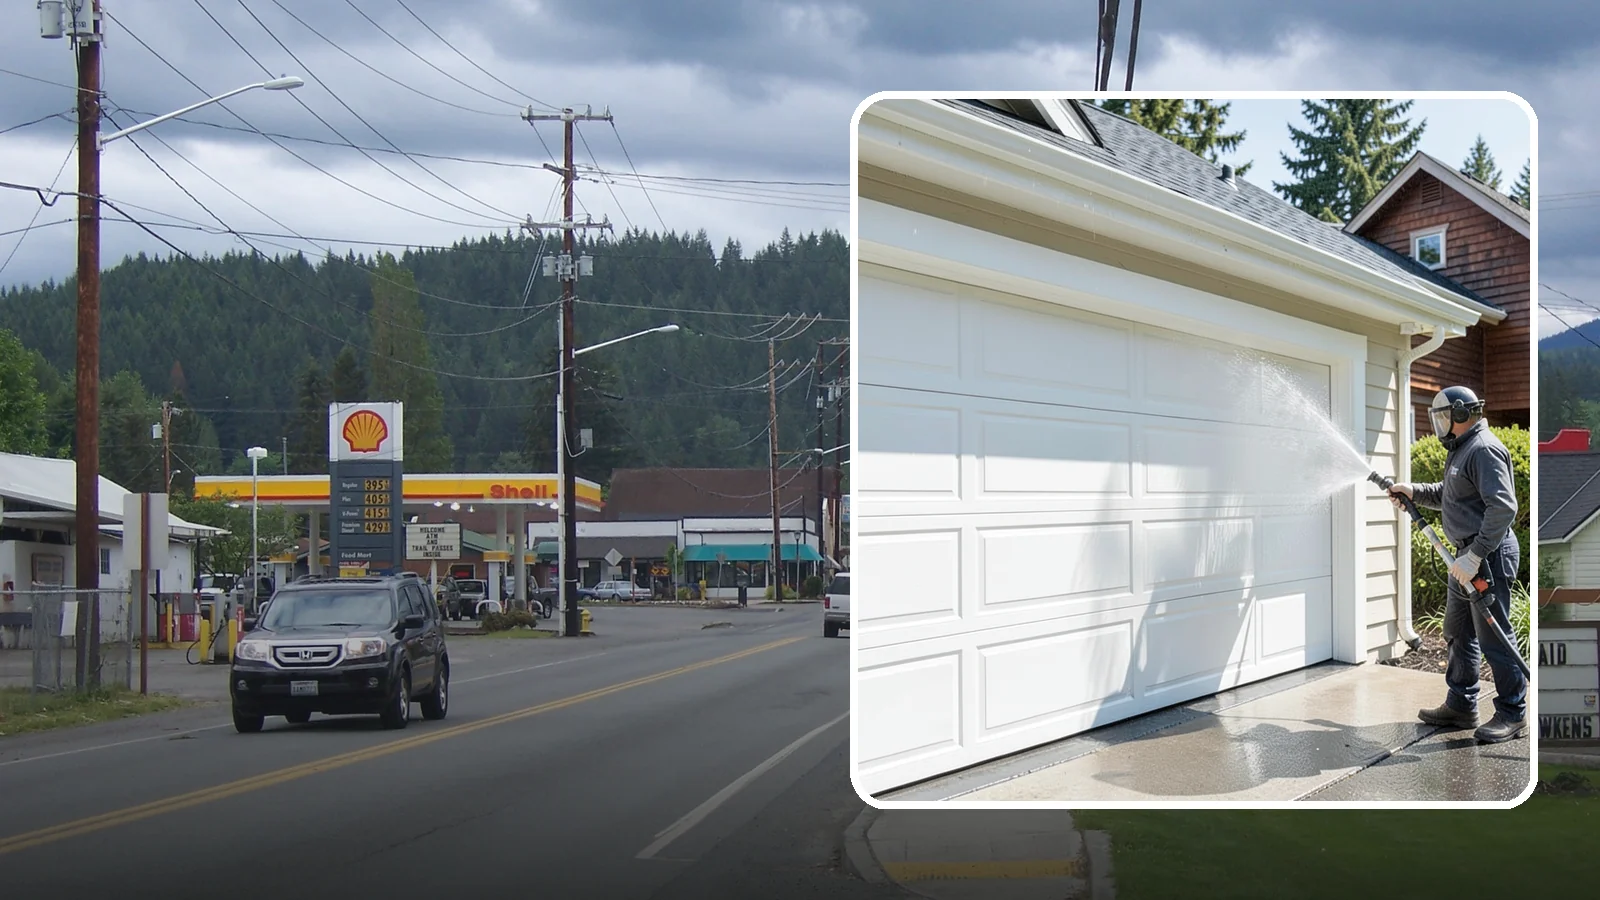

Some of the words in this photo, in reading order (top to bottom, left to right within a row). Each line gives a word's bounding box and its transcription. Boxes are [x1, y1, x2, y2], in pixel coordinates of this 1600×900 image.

[365, 480, 383, 490] 395
[490, 484, 547, 499] Shell
[365, 494, 383, 504] 405
[365, 508, 383, 518] 415
[366, 522, 383, 532] 429
